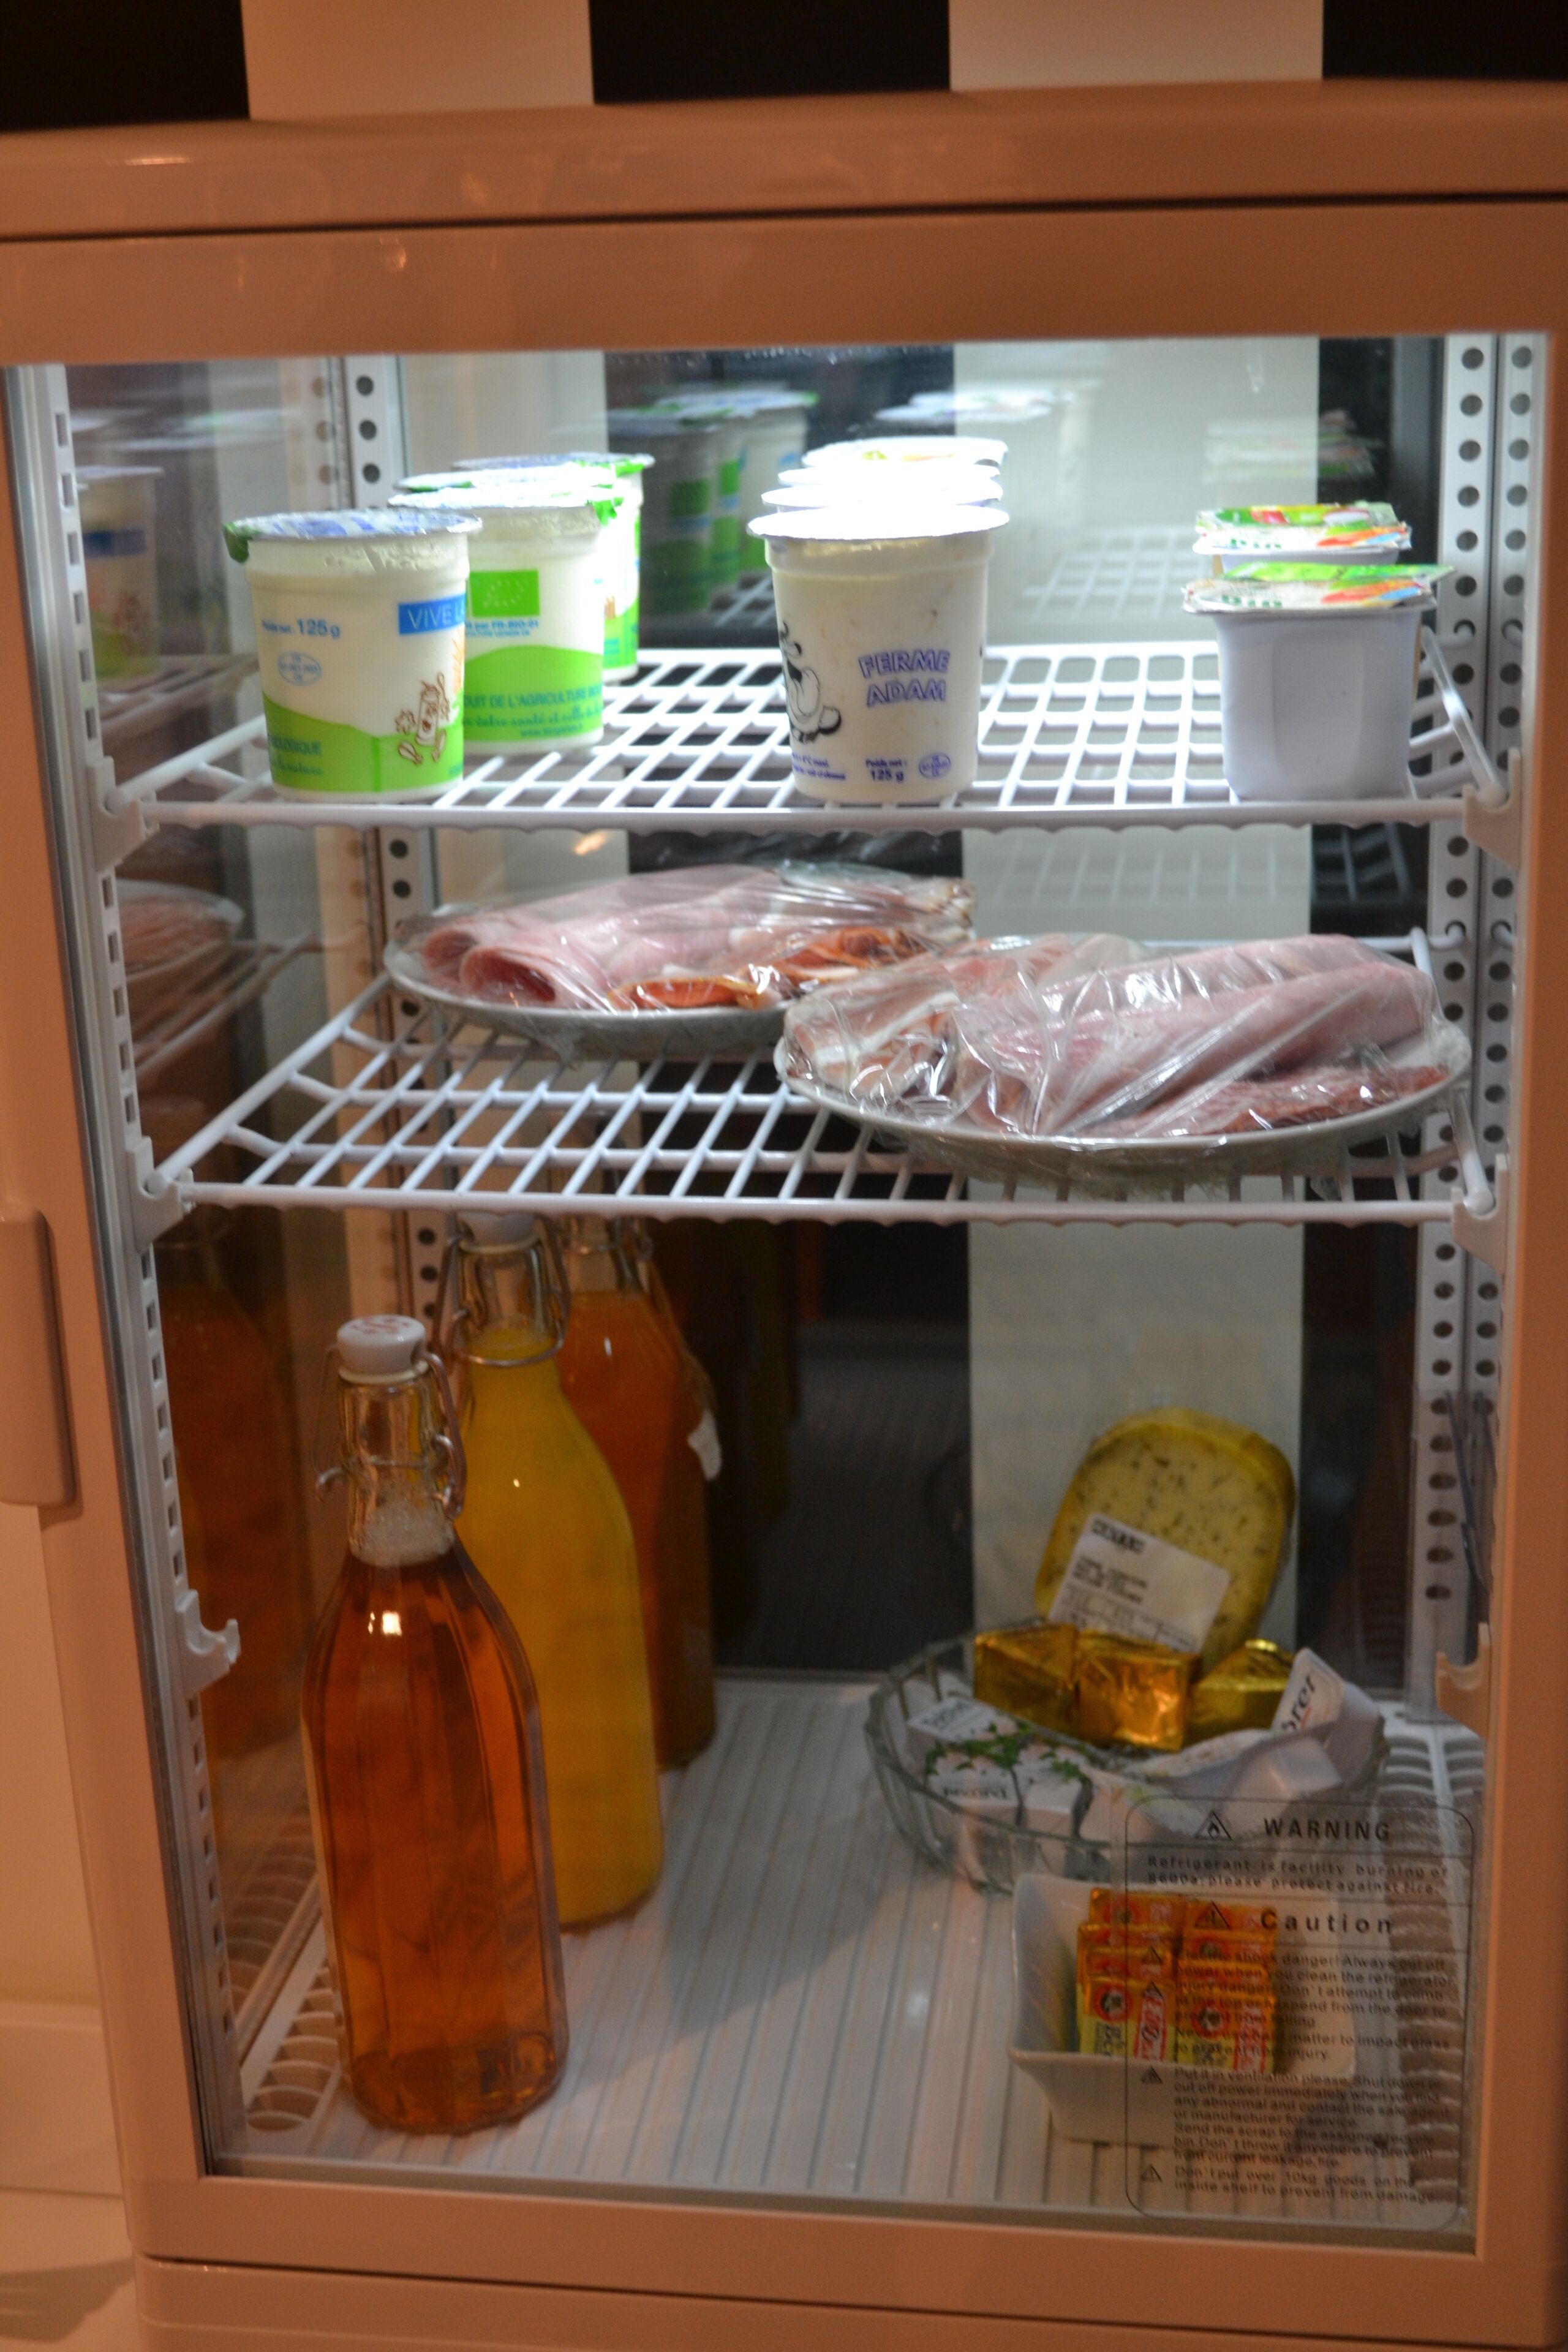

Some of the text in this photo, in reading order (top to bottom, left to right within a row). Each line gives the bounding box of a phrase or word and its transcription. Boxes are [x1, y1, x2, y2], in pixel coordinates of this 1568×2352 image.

[407, 603, 452, 630] VIVE
[858, 649, 951, 679] FERME
[866, 678, 946, 708] ADAM
[1263, 1817, 1390, 1840] WARNING
[1148, 1855, 1250, 1871] Refrigerant
[1260, 1908, 1392, 1933] Caution
